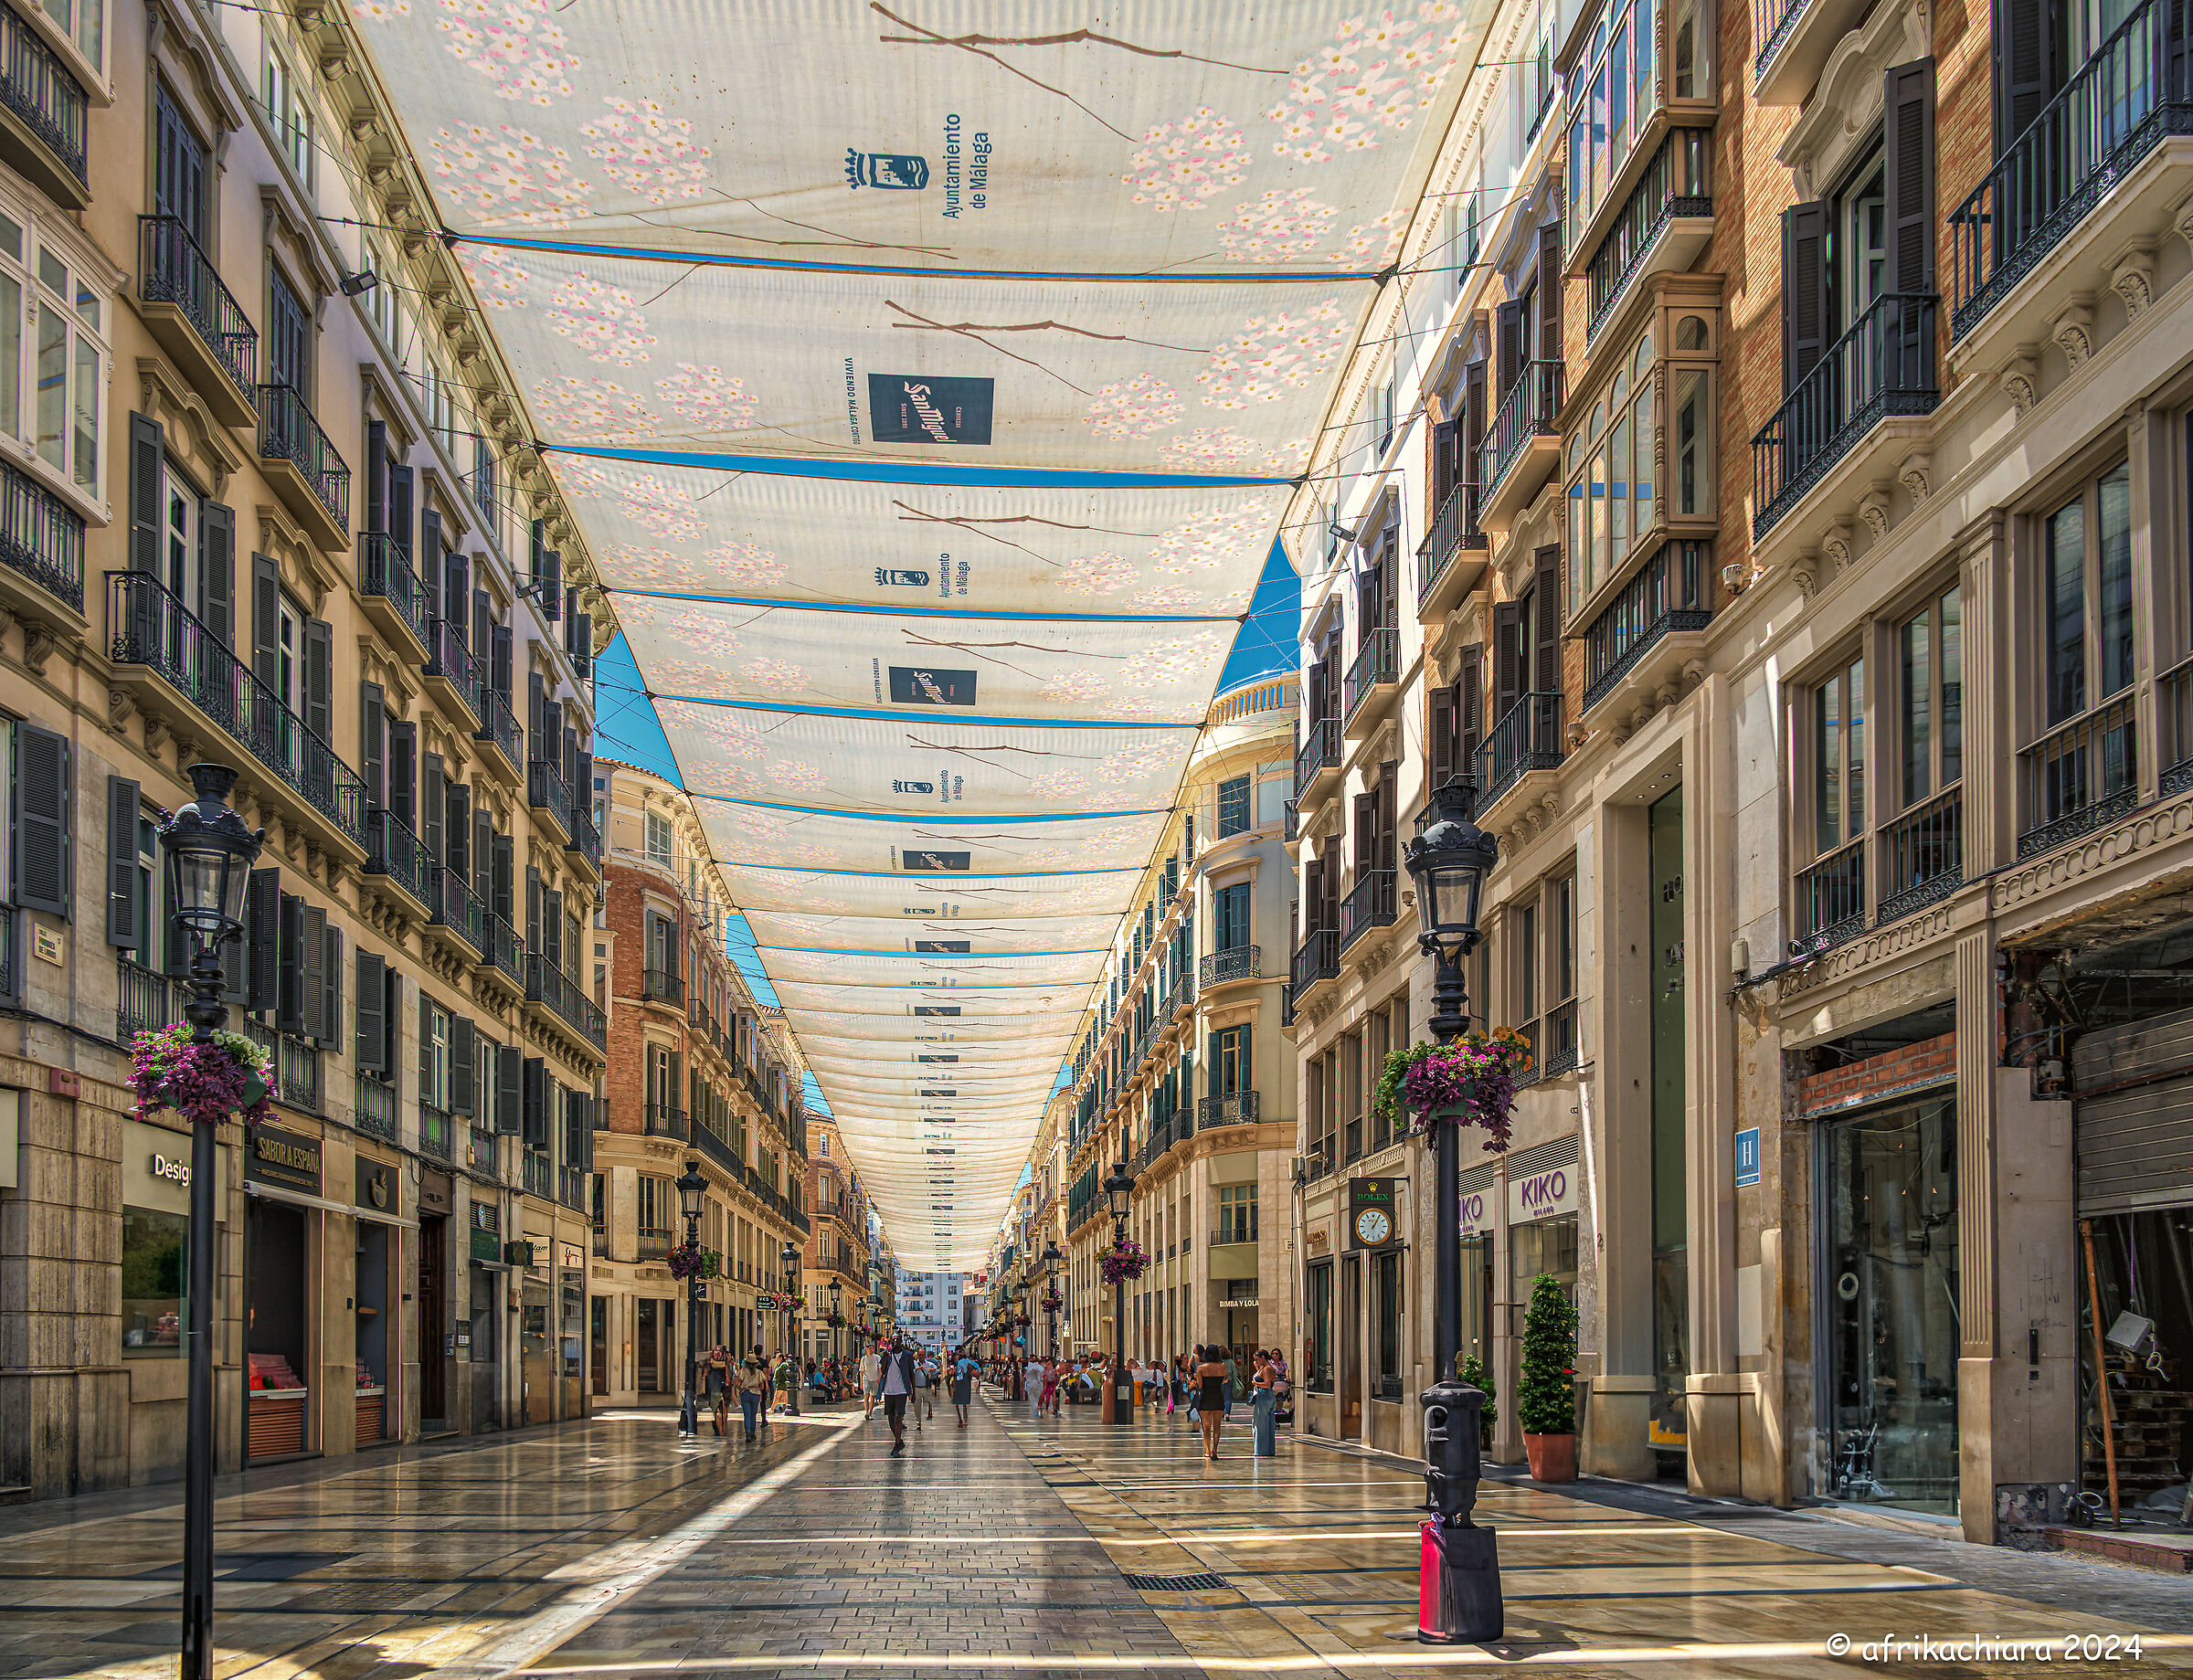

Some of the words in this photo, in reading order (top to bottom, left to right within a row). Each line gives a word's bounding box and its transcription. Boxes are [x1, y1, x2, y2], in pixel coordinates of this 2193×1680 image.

[943, 113, 963, 219] Ayuntamiento
[969, 132, 992, 191] Málaga
[969, 193, 986, 209] de
[844, 357, 855, 397] VIVIENDO
[848, 399, 859, 426] MÁLAGA
[938, 553, 952, 598] Ayuntamiento
[956, 561, 970, 586] Málaga
[258, 1136, 286, 1165] SABOR
[287, 1146, 292, 1167] A
[293, 1146, 320, 1174] ESPAÑA
[1743, 1140, 1753, 1167] H
[1521, 1170, 1566, 1208] KIKO
[1459, 1194, 1482, 1222] IKO
[1533, 1206, 1554, 1217] MILANO
[1219, 1300, 1238, 1308] BIMBA
[1244, 1299, 1260, 1307] LOLA
